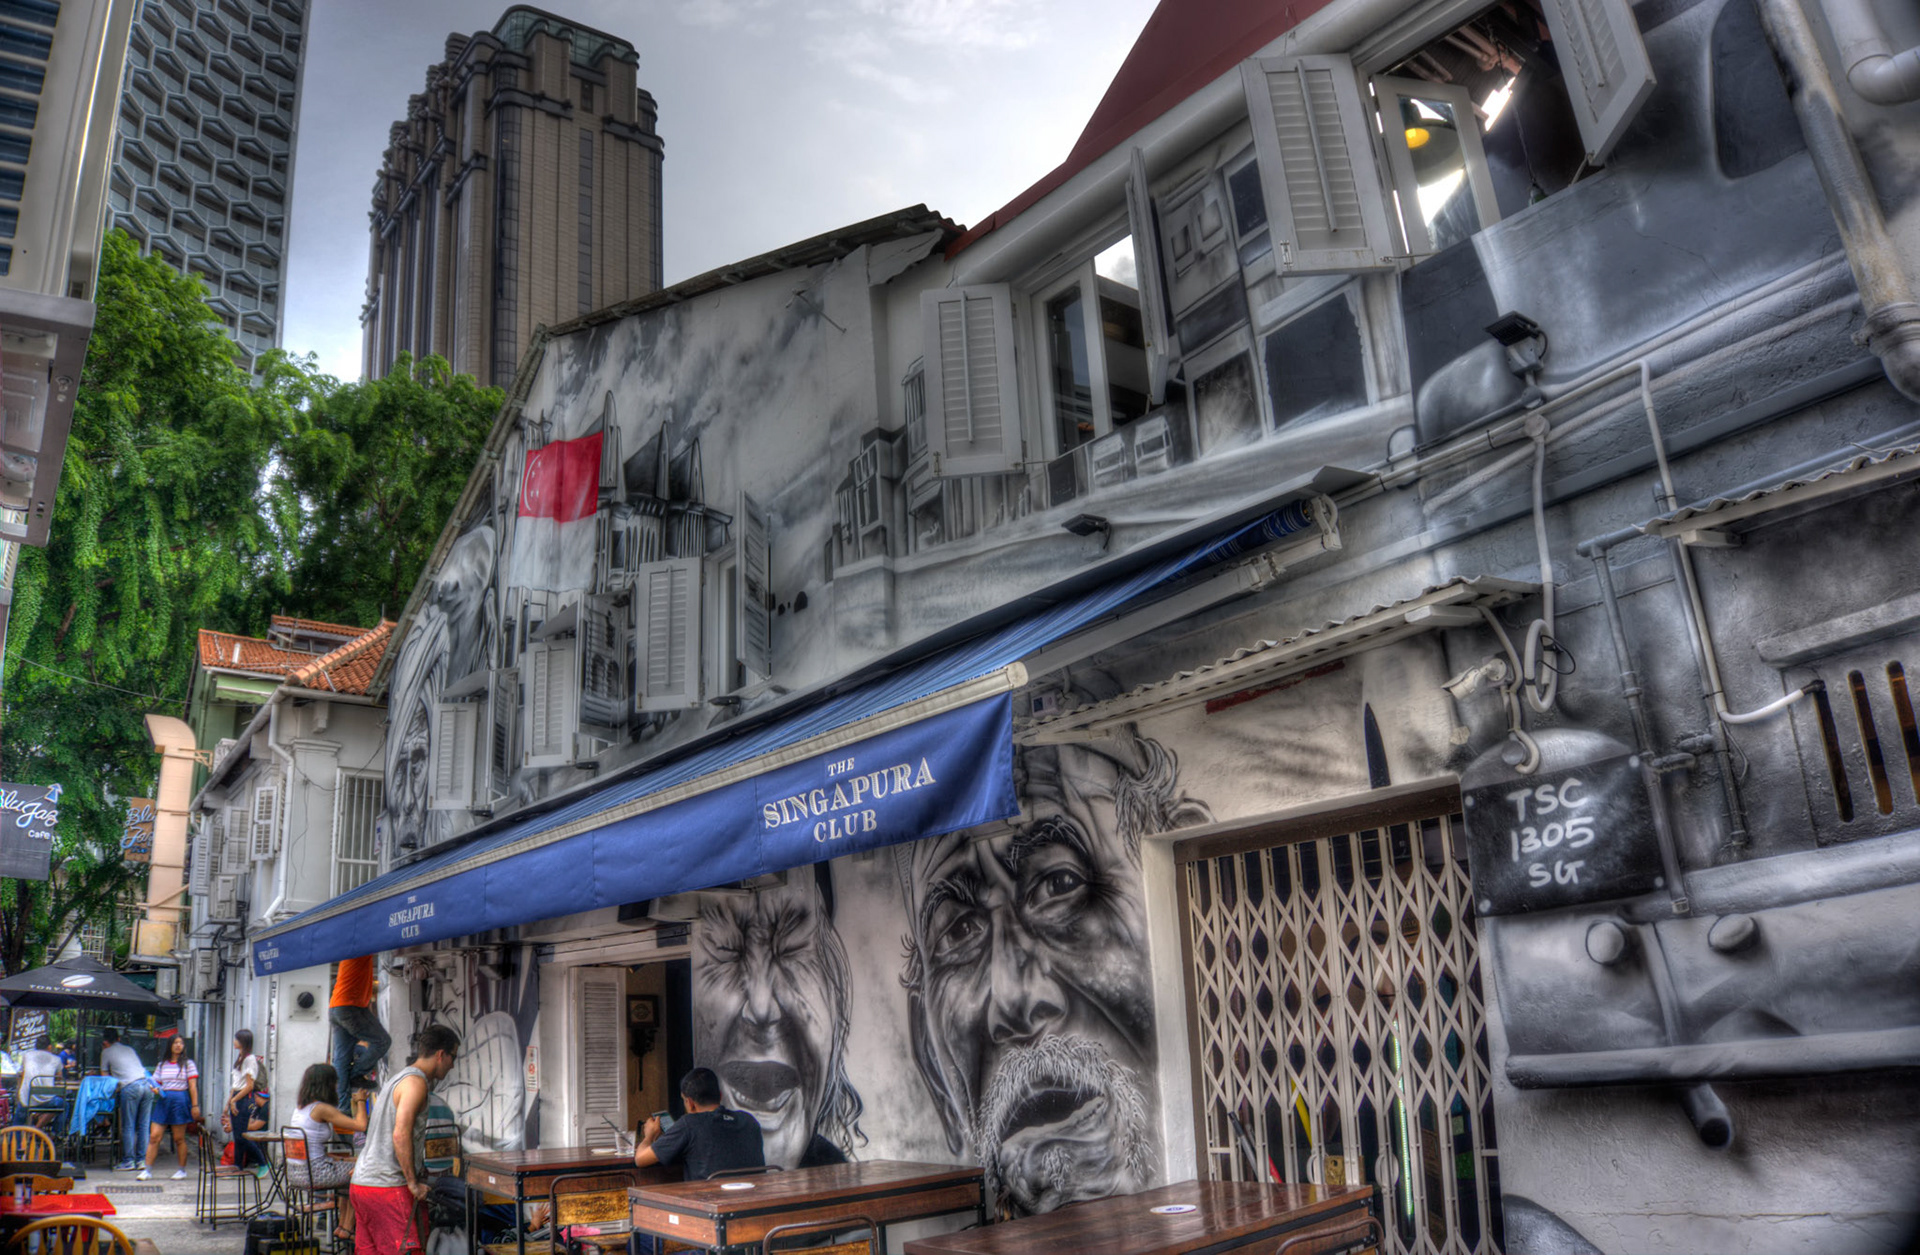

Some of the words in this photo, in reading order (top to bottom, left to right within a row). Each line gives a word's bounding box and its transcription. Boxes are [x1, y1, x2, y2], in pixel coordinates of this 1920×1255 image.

[827, 757, 855, 777] THE
[763, 756, 937, 829] SINGAPURA
[1506, 777, 1588, 822] TSC
[28, 829, 51, 840] Cafe
[813, 808, 878, 843] CLUB
[1511, 816, 1595, 862] 1305
[1528, 860, 1585, 888] SG
[389, 902, 434, 928] SINGAPURA
[401, 924, 419, 939] CLUB
[76, 988, 119, 997] ESTATE
